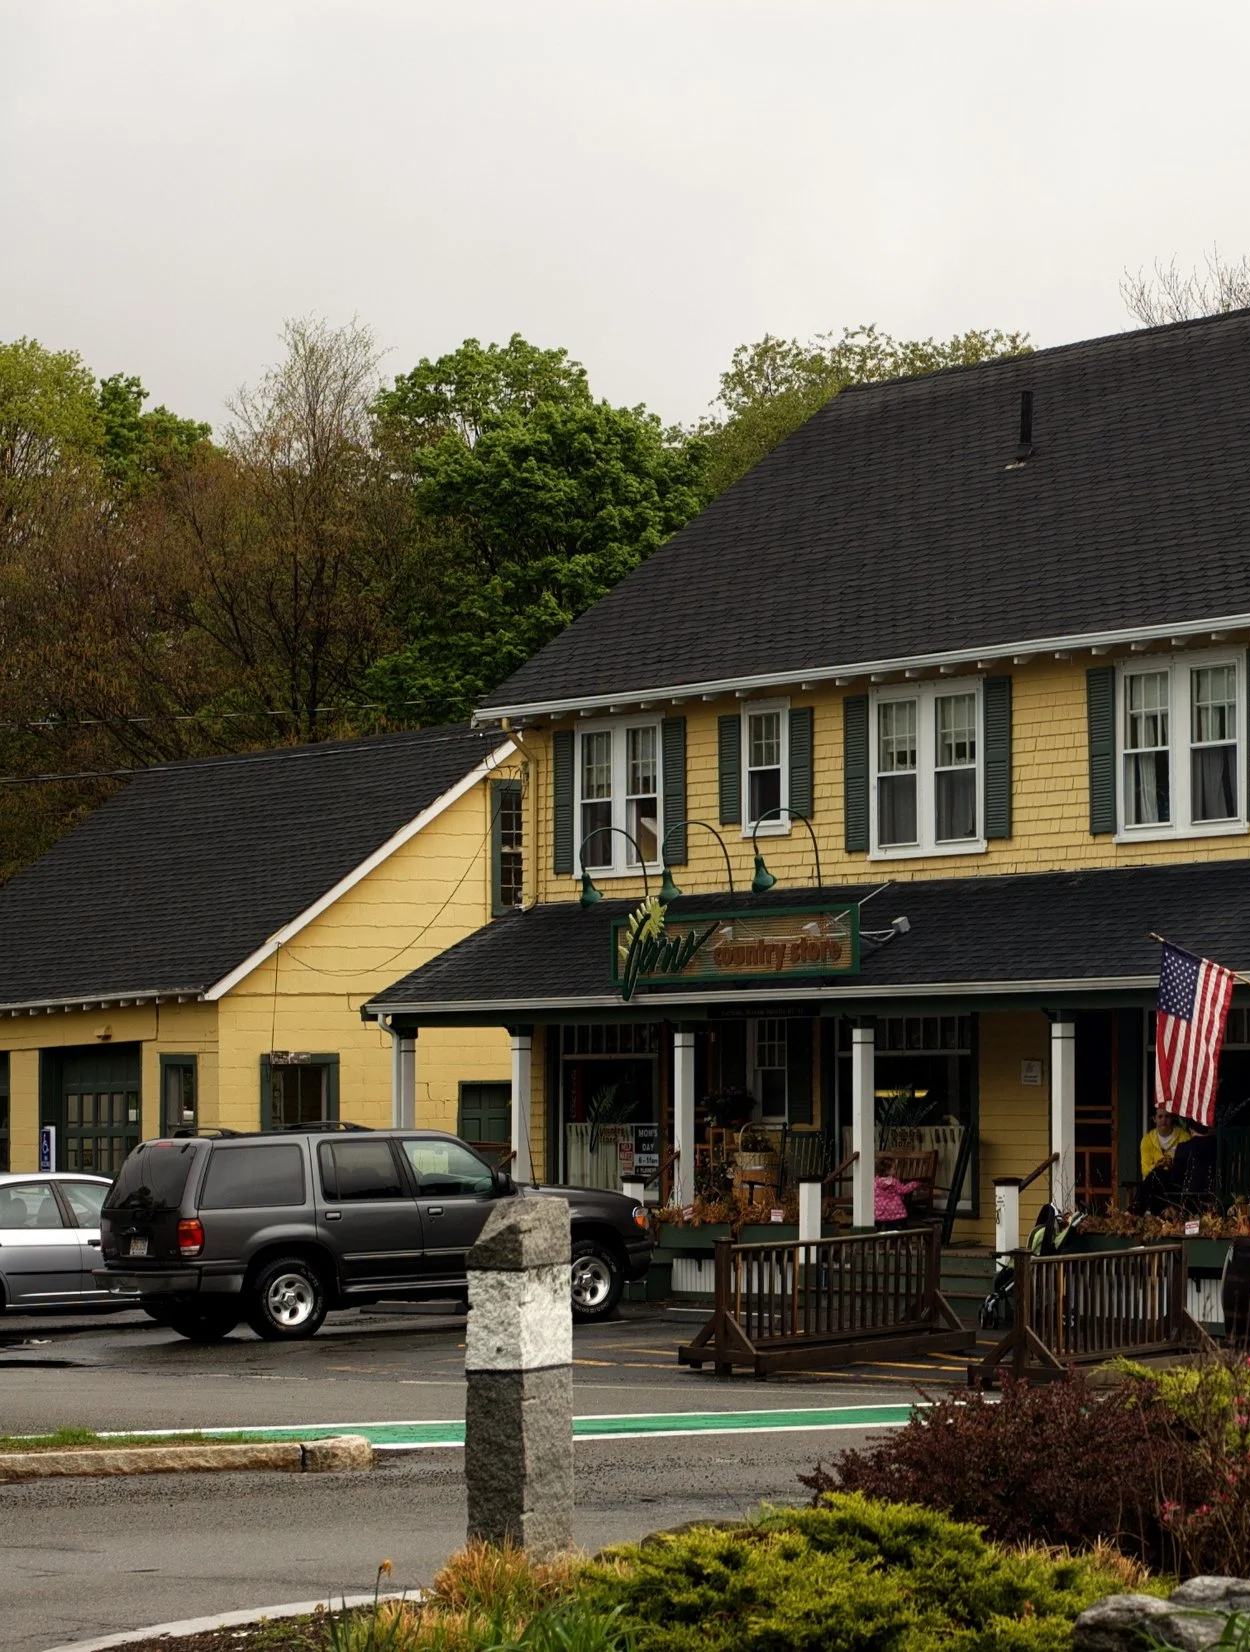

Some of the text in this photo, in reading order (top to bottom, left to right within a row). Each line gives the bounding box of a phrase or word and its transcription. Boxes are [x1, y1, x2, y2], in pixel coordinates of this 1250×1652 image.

[713, 940, 786, 971] country
[790, 937, 842, 962] store
[642, 1143, 655, 1152] DAY
